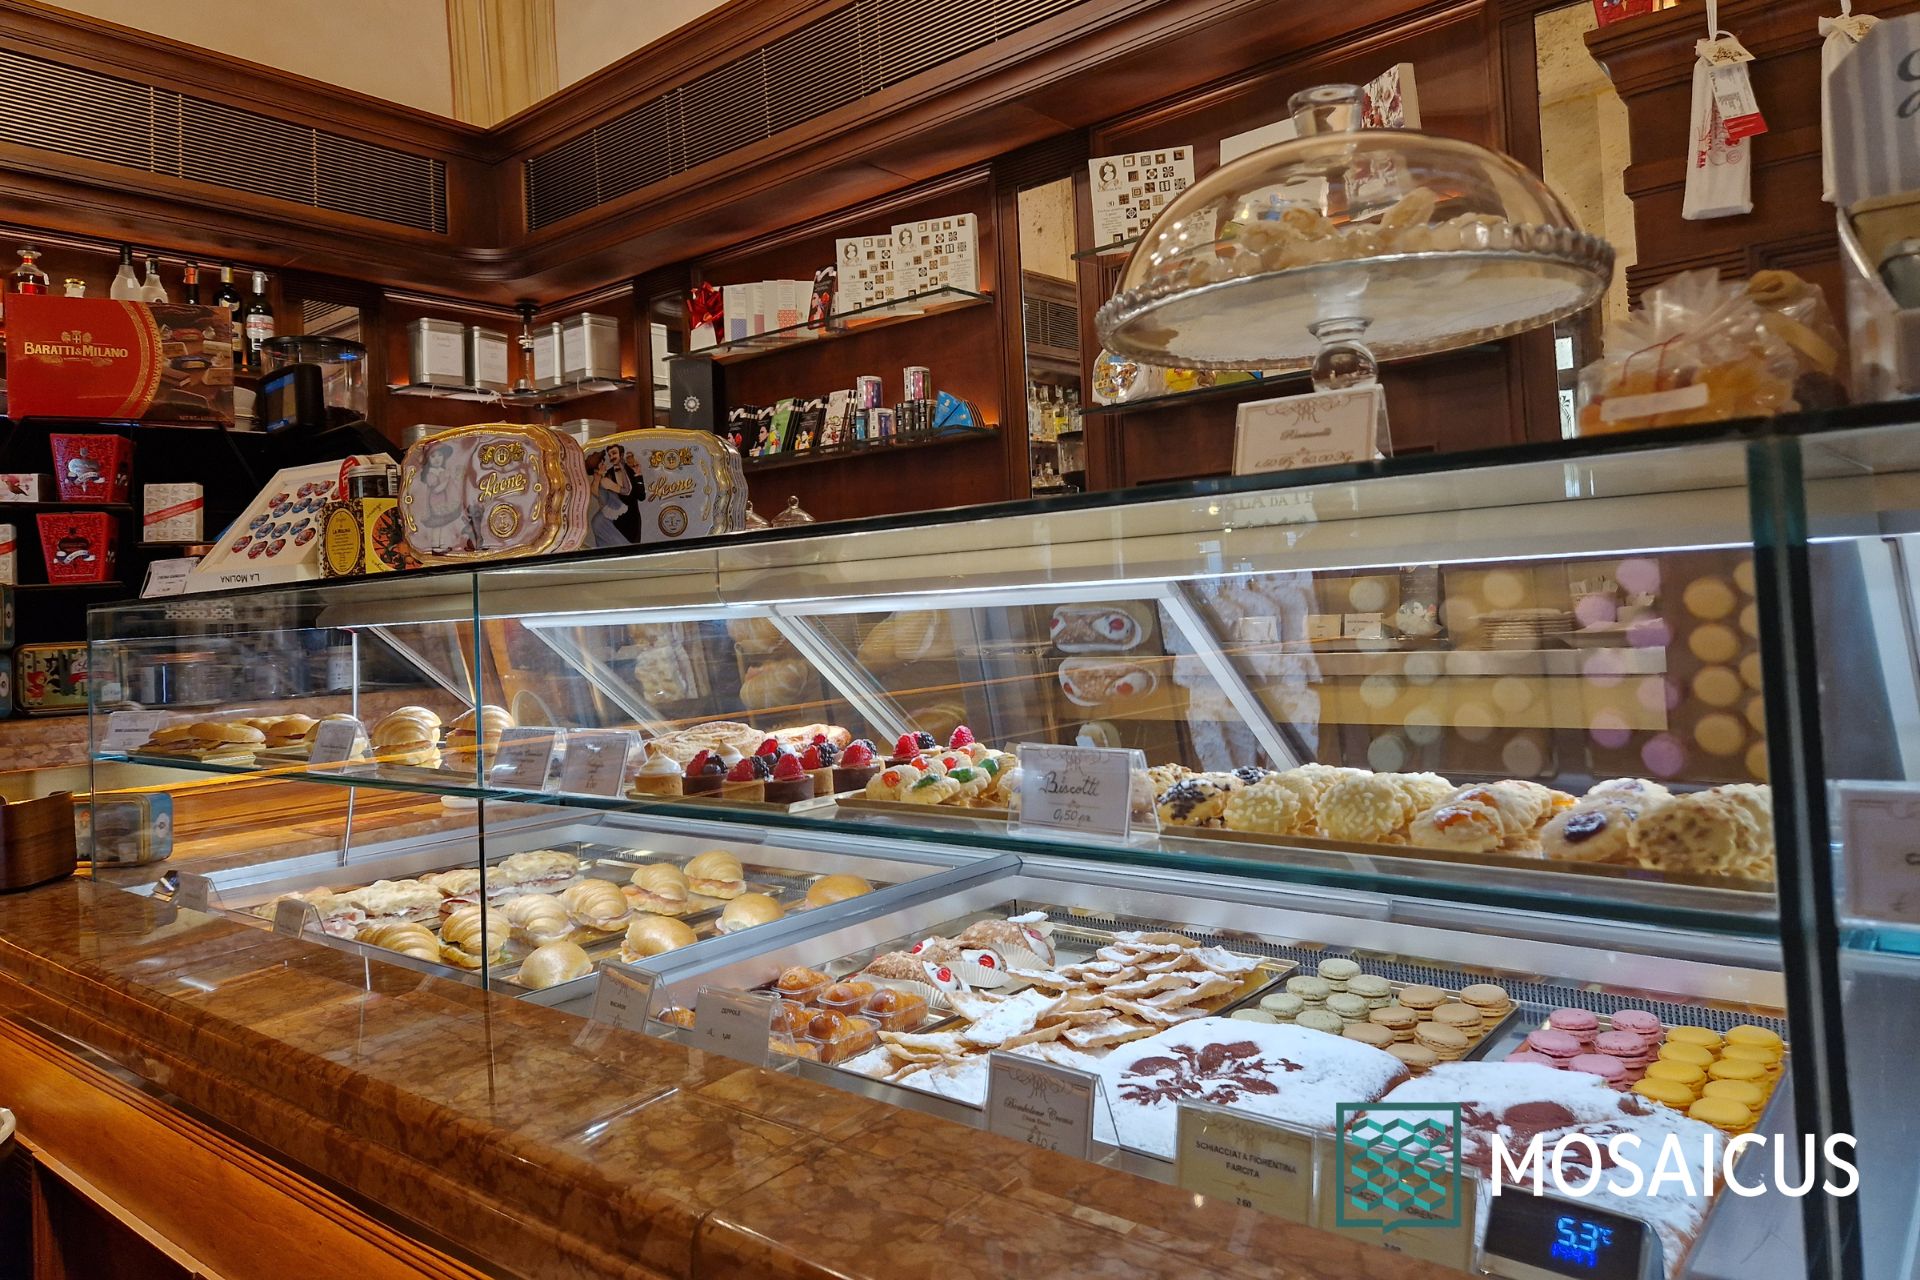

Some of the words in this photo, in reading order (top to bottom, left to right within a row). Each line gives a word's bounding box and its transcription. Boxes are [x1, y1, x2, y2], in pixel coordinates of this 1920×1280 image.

[478, 472, 527, 502] Leone
[647, 475, 697, 503] Leone
[220, 574, 248, 583] MOLINA
[249, 573, 260, 582] LA
[1039, 771, 1099, 797] Biscotti
[1195, 1140, 1248, 1161] SCHIACCIATA
[1248, 1154, 1297, 1174] FIORENTINA
[1225, 1161, 1260, 1178] FARCITA
